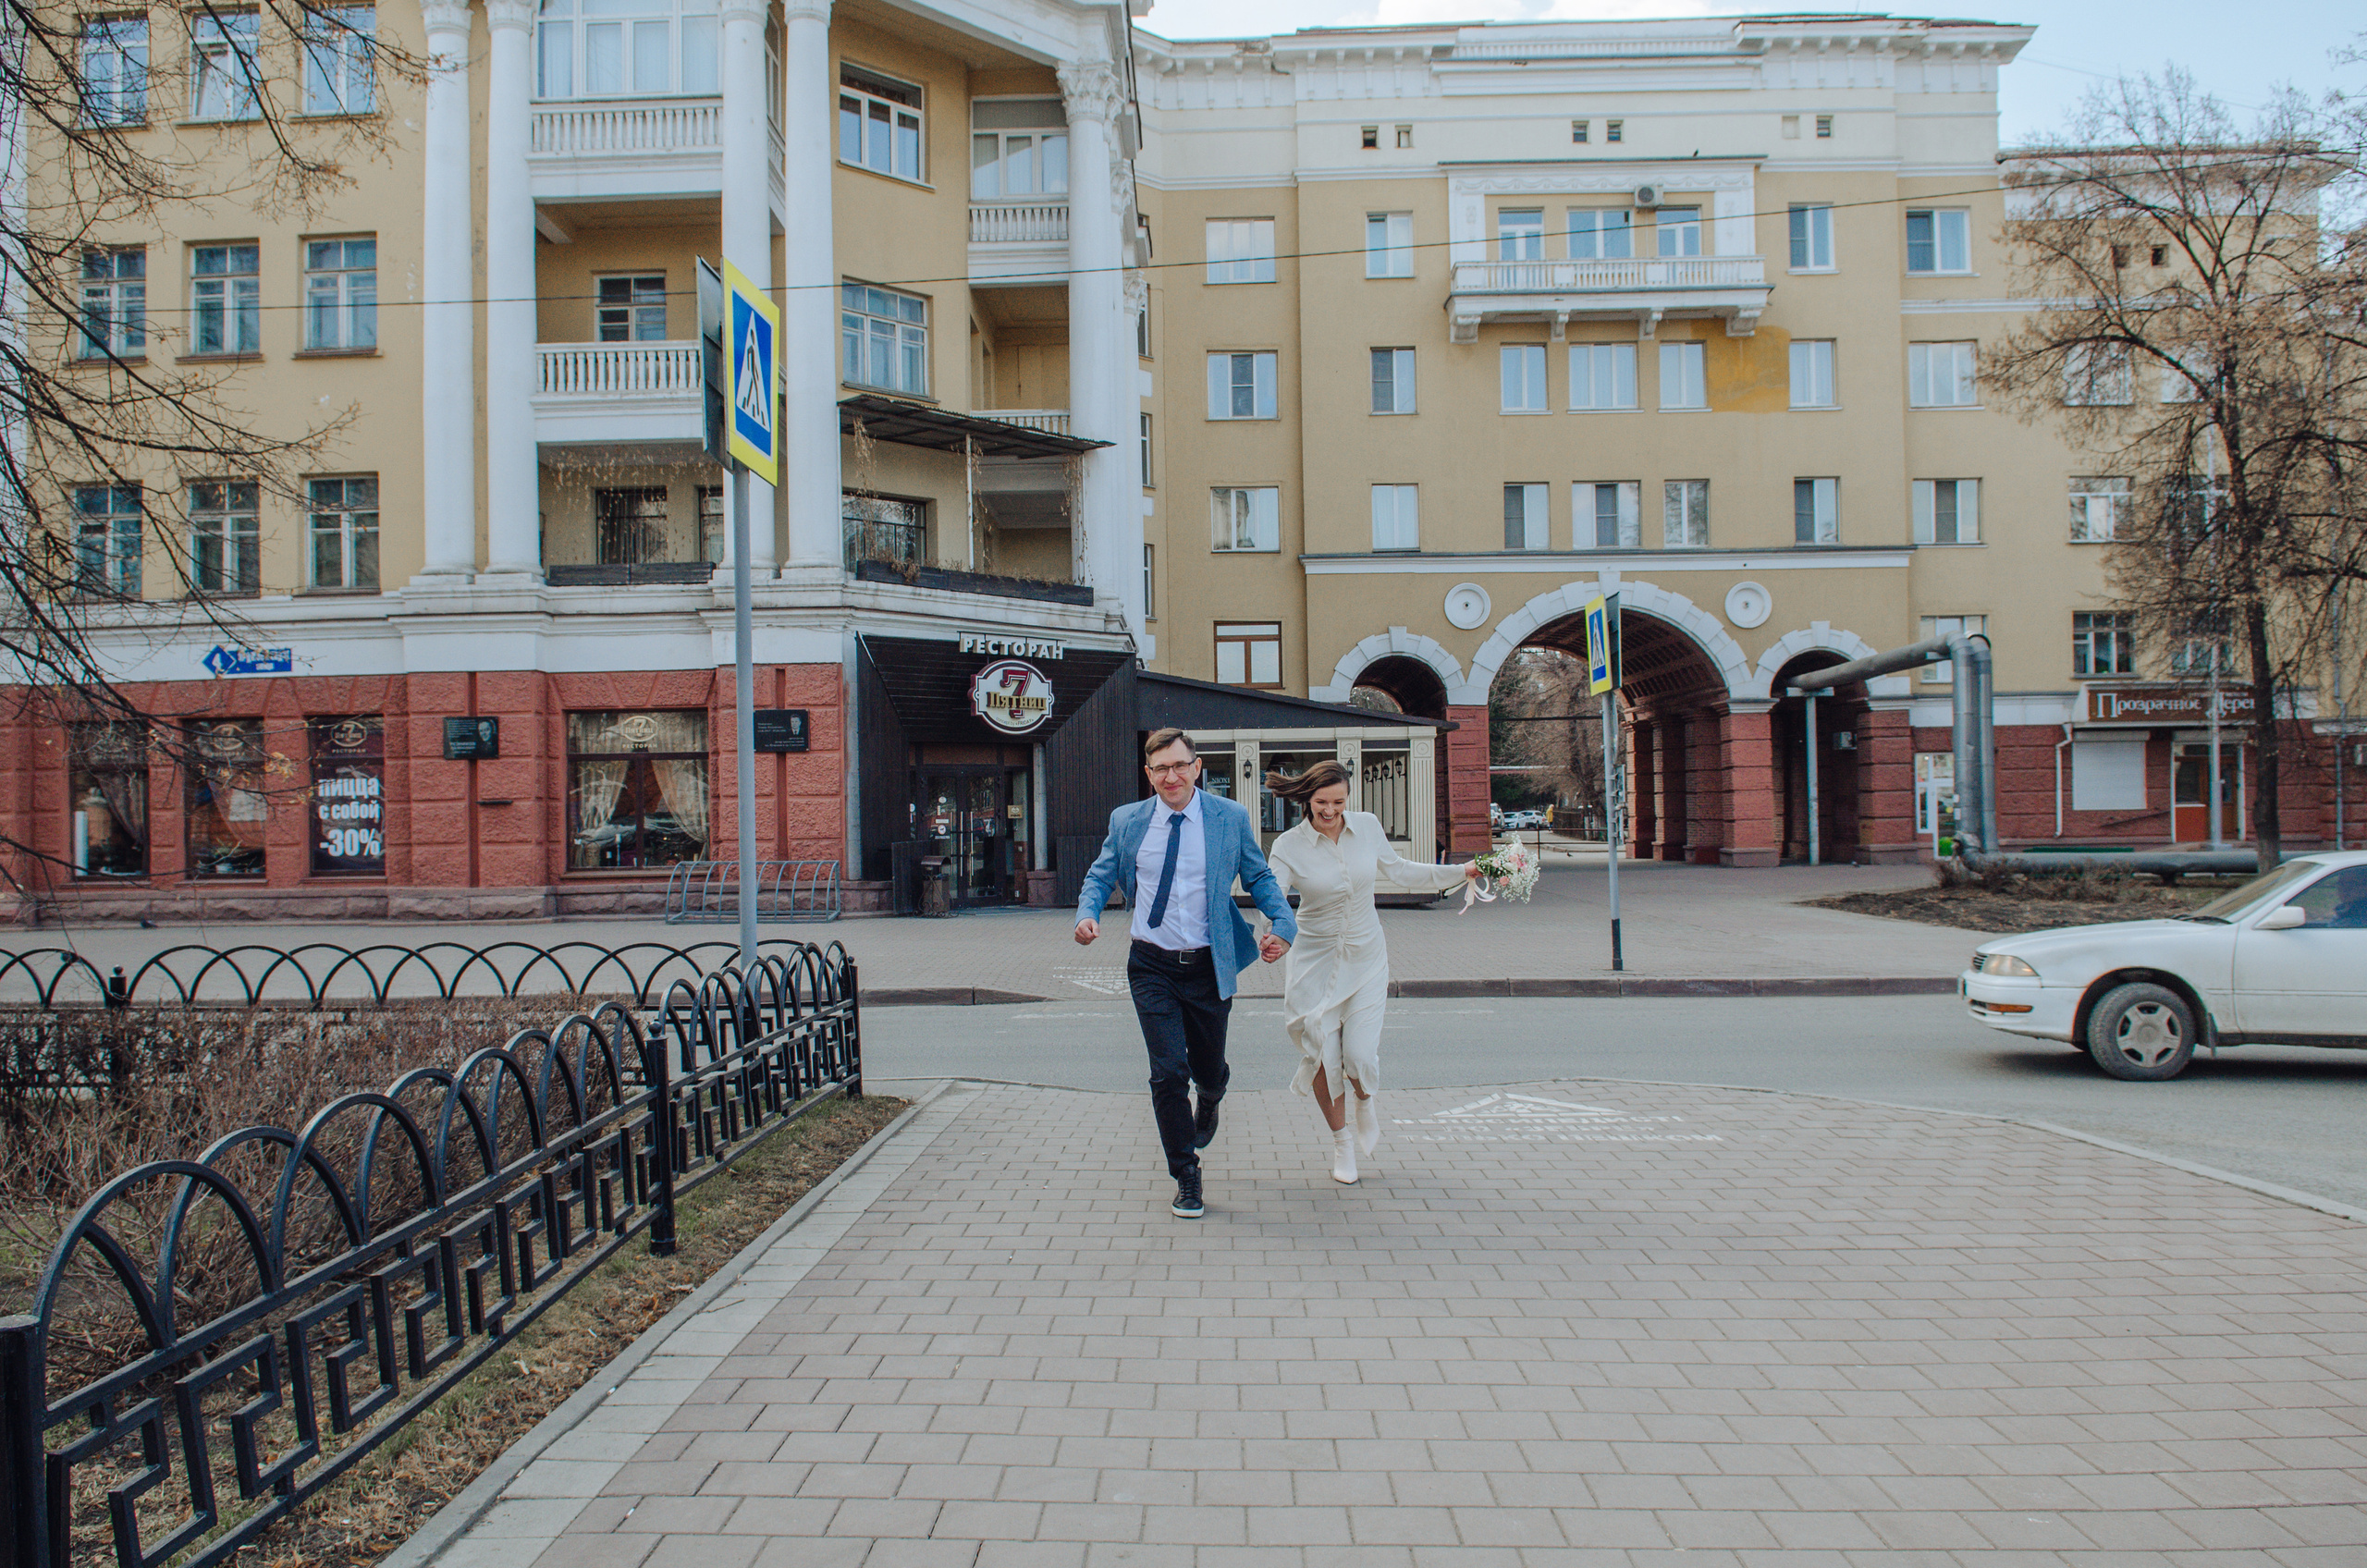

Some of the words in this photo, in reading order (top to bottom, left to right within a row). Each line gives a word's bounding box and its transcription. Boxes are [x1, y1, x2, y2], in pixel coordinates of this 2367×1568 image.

[960, 637, 1063, 660] РЕСТОРАН
[987, 692, 1047, 711] Пятниц
[1000, 668, 1032, 718] 7
[2097, 692, 2201, 718] Прозрачное
[342, 724, 355, 742] 7
[633, 718, 646, 737] 7
[319, 803, 330, 820] с
[331, 800, 381, 823] собой
[319, 828, 381, 857] -30%
[1392, 1116, 1684, 1124] ВЕЛОСИПЕДИСТ!
